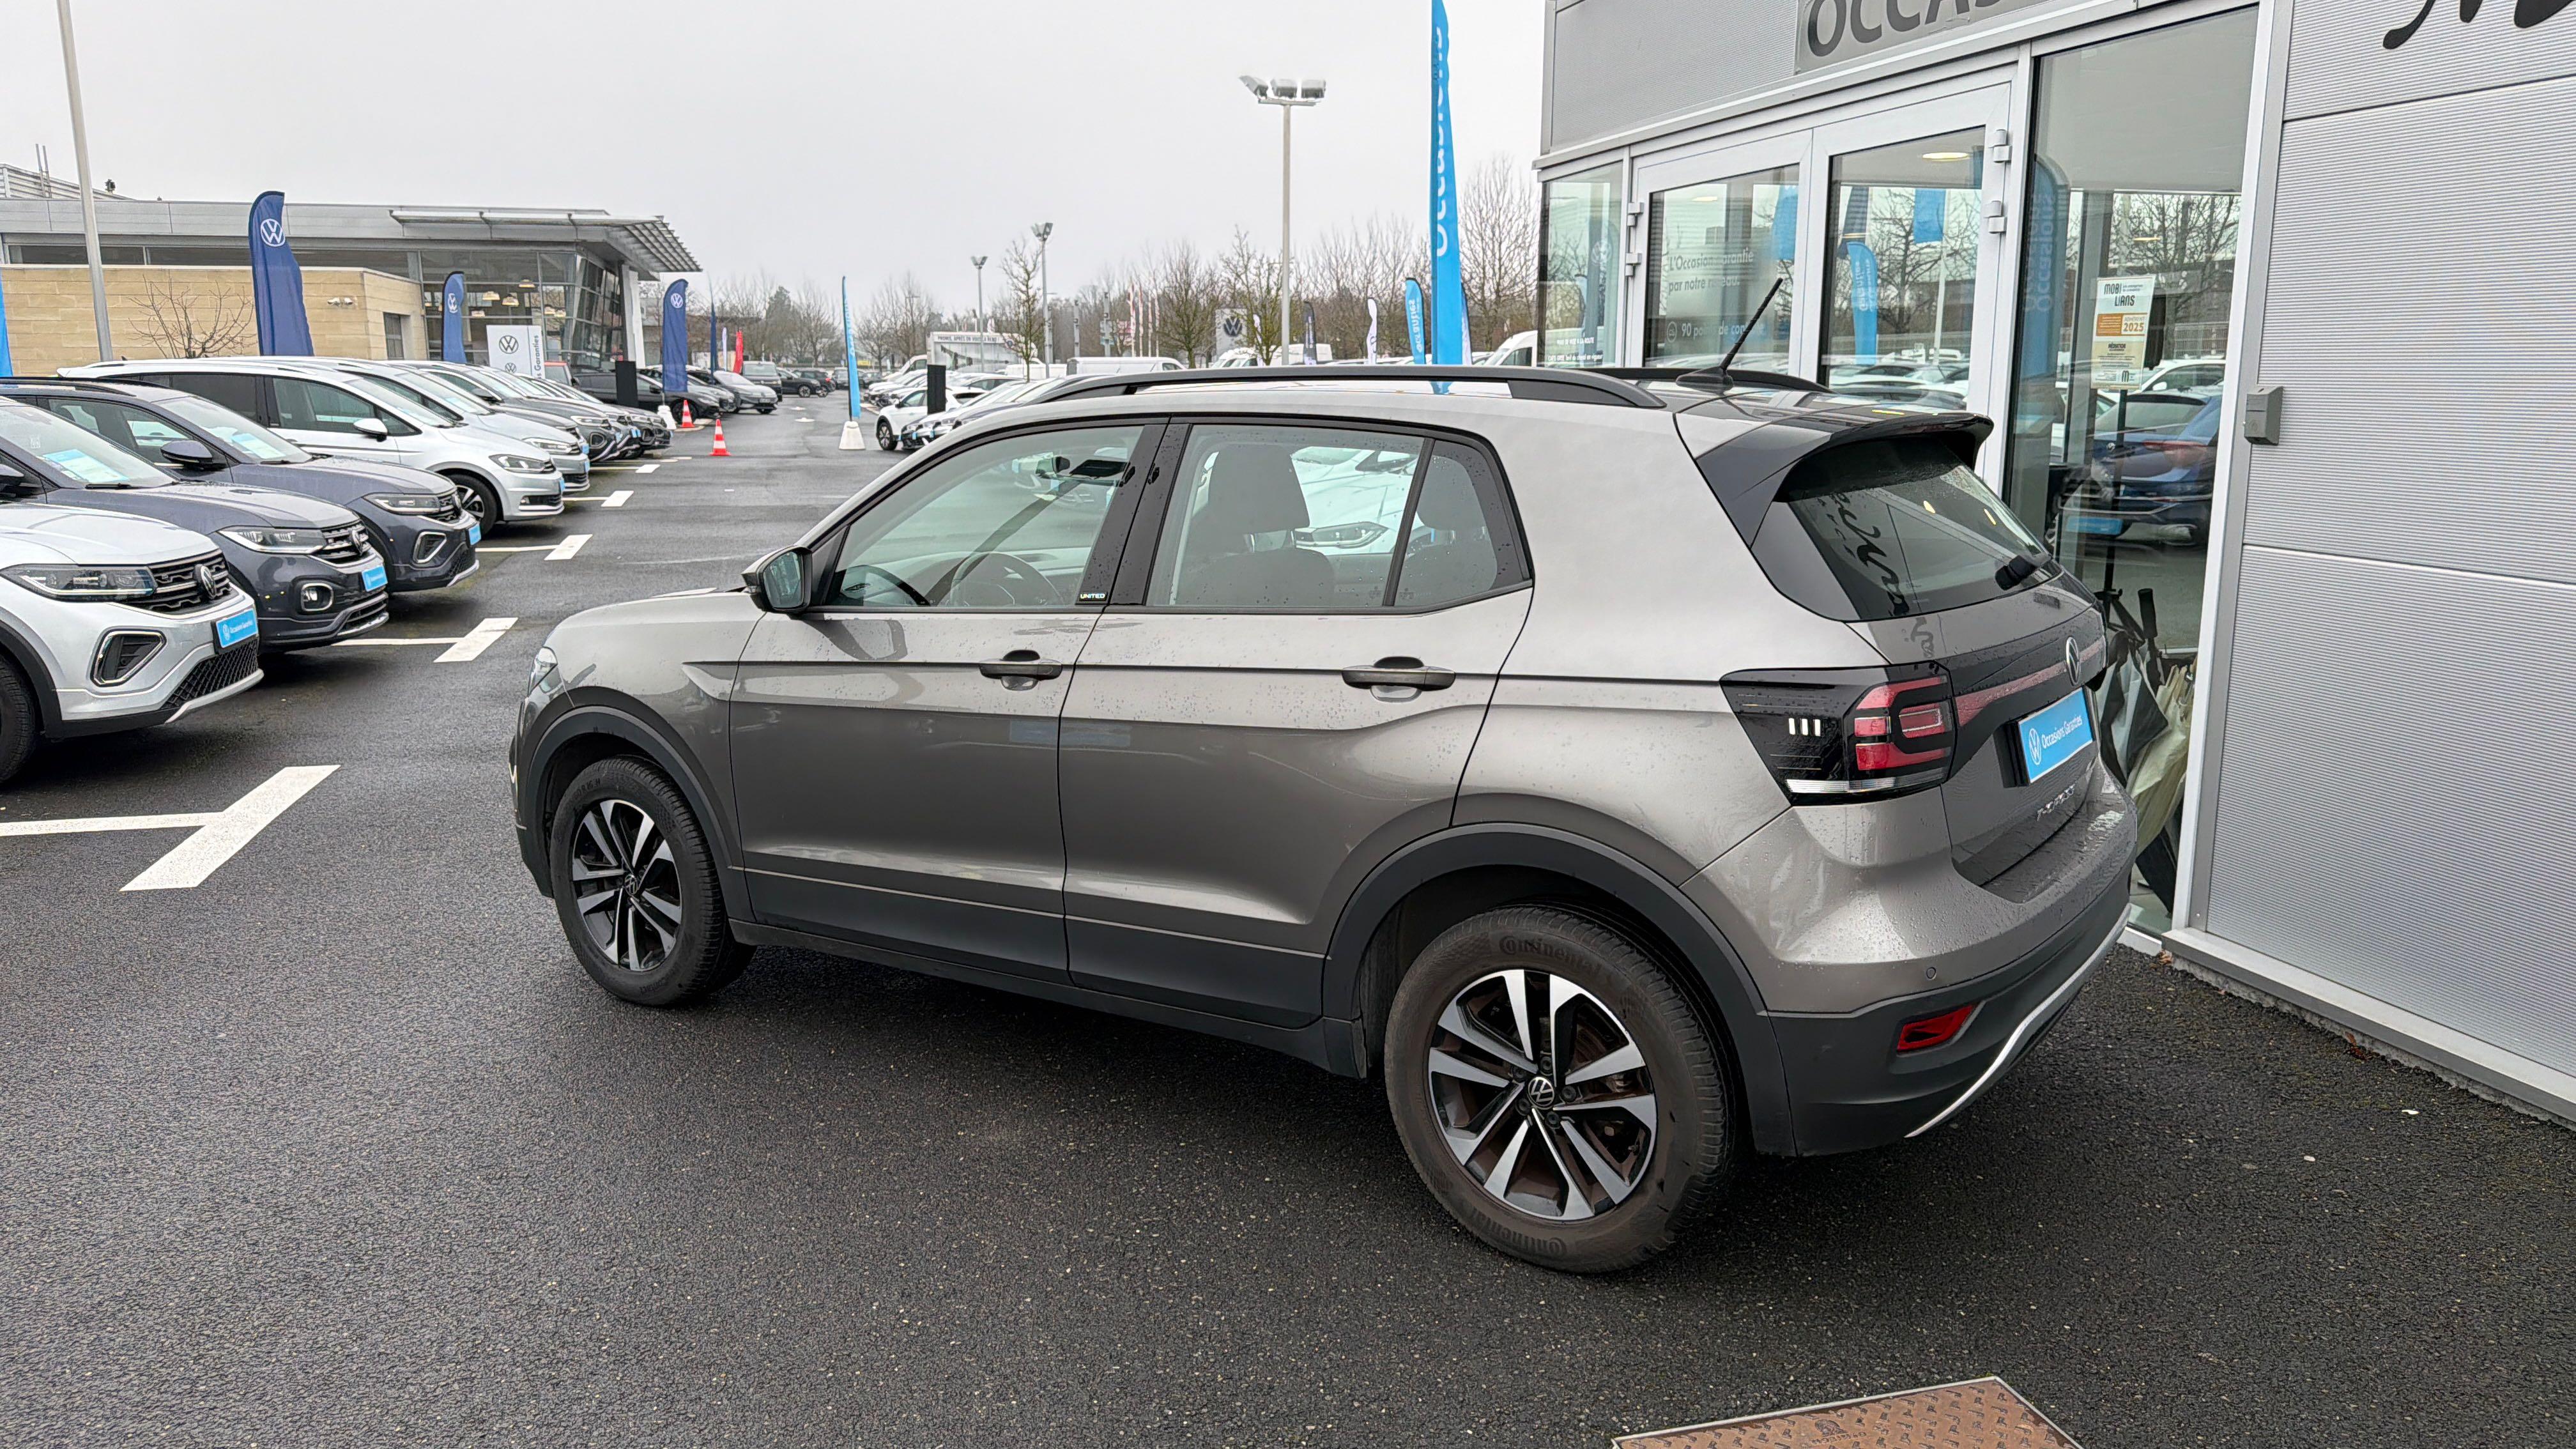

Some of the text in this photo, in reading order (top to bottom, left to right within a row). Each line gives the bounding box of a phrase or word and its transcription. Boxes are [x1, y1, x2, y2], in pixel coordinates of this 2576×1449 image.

[1669, 281, 1682, 295] par
[1684, 276, 1705, 291] notre
[2104, 283, 2122, 295] MOBI
[2114, 295, 2135, 307] LIANS
[1681, 322, 1692, 337] 90
[2123, 322, 2145, 332] 2025
[2041, 724, 2066, 749] Occasions
[2064, 714, 2083, 735] Garanties
